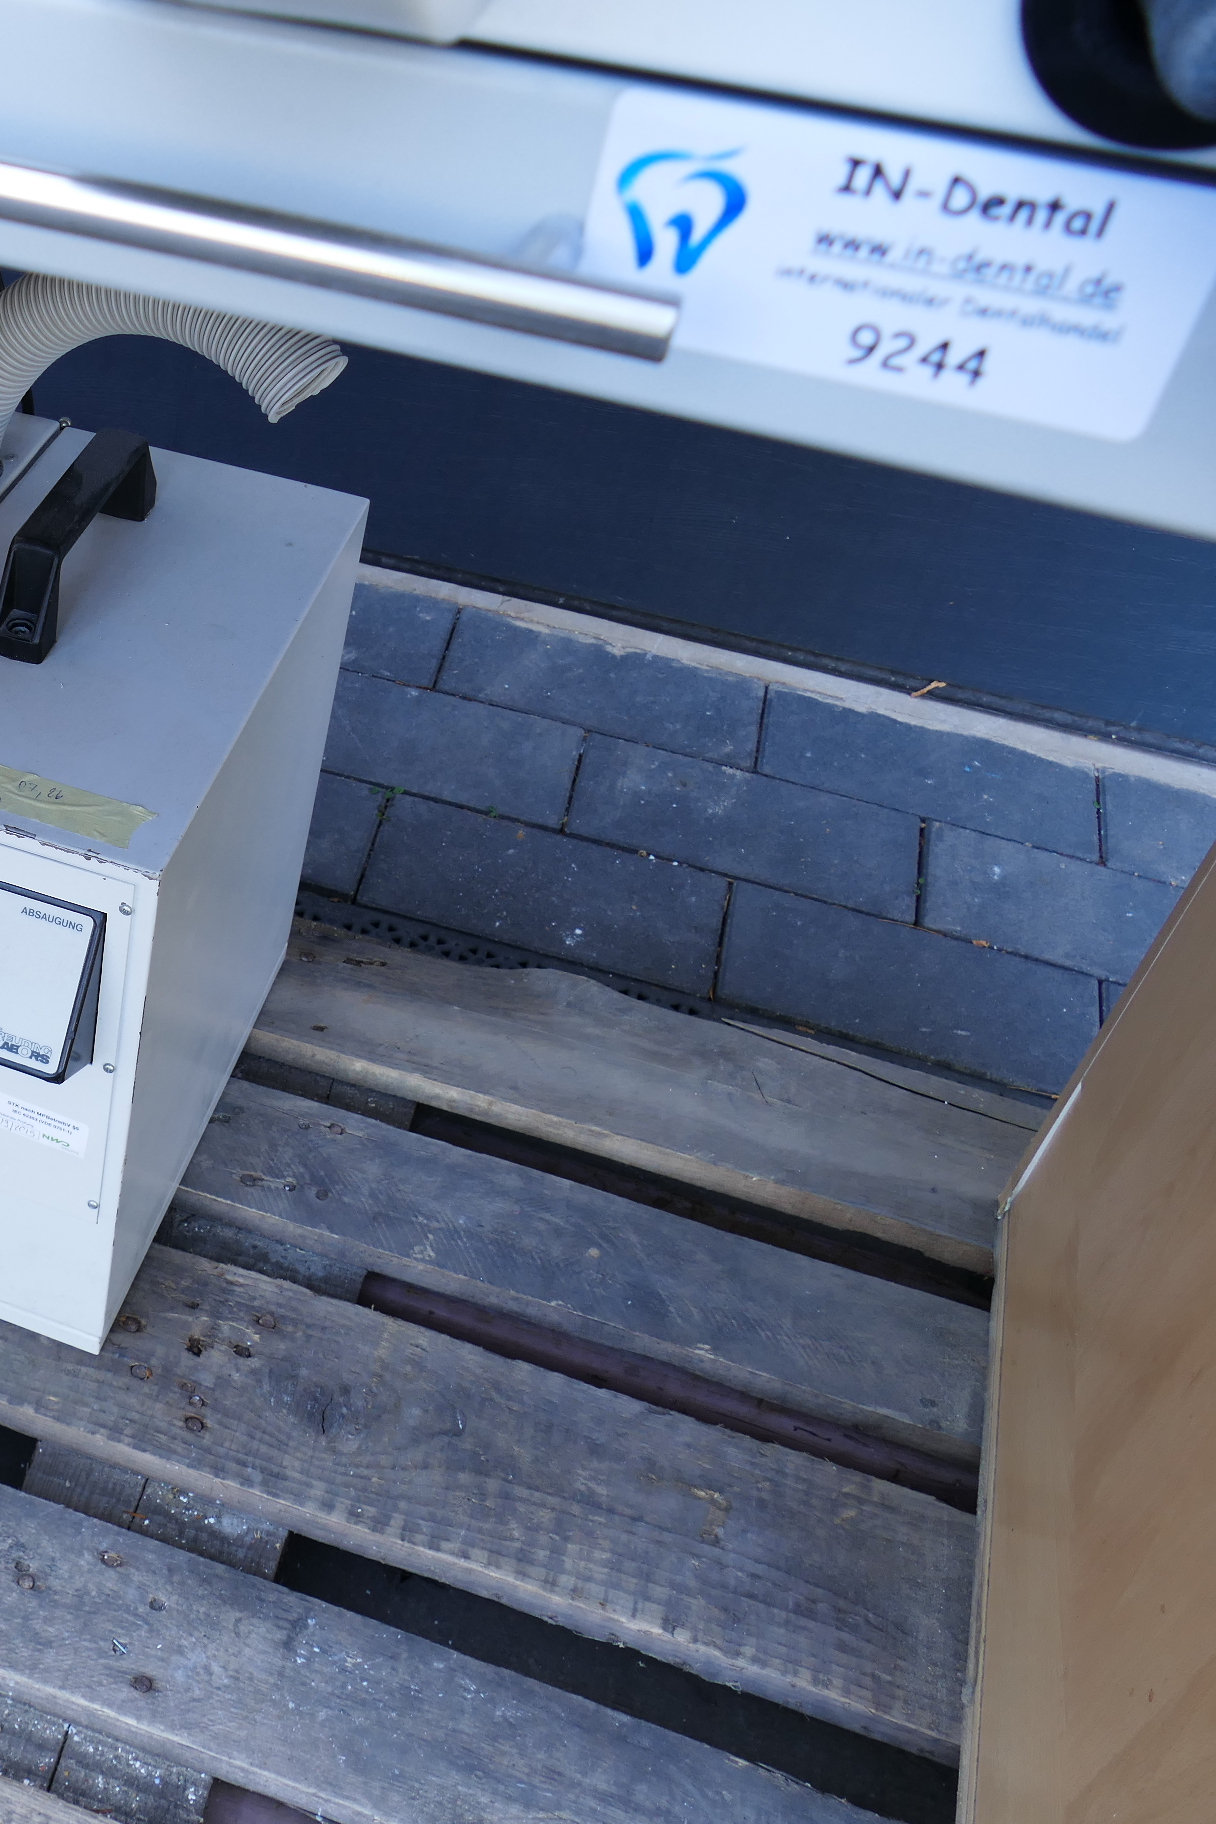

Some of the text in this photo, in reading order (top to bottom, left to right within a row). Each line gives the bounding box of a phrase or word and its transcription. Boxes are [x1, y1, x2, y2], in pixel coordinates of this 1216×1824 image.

[837, 156, 1117, 241] IN-Dental
[813, 228, 1125, 306] www.in-dental.de
[844, 322, 990, 388] 9244
[21, 906, 84, 932] ABSAUGUNG
